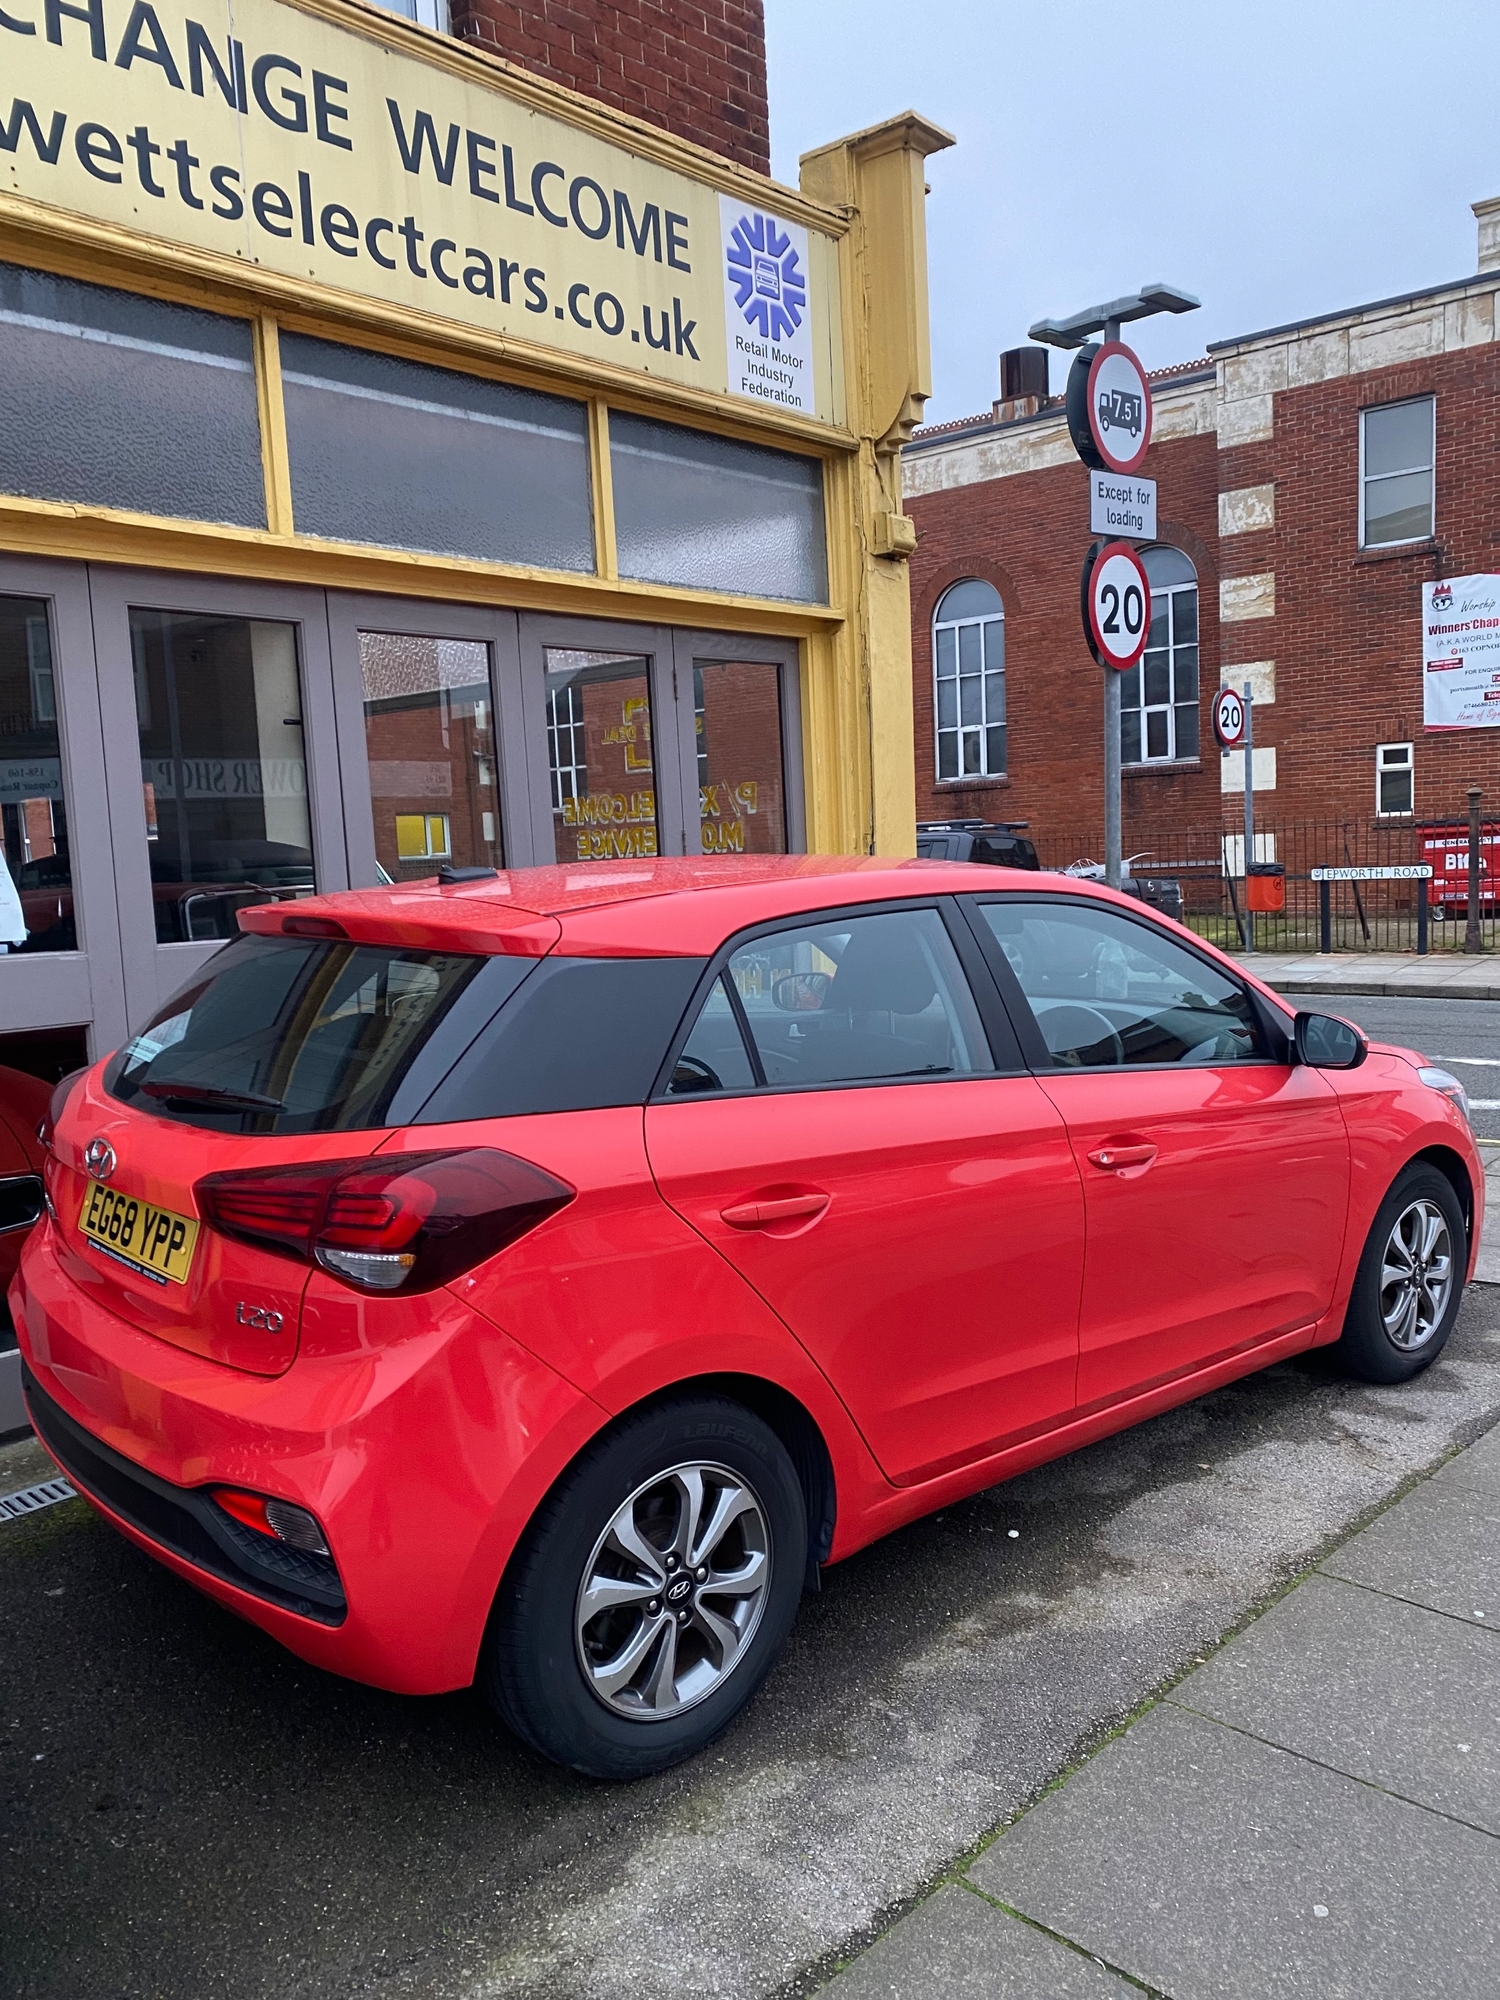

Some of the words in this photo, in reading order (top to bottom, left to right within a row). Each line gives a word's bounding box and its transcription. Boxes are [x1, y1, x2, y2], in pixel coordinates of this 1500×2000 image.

[0, 0, 353, 151] HANGE
[386, 97, 692, 273] WELCOME
[0, 97, 701, 361] wettselectcars.co.uk
[735, 335, 768, 359] Retail
[771, 347, 804, 369] Motor
[747, 359, 794, 389] Industry
[741, 377, 802, 407] Federation
[1098, 482, 1133, 504] Except
[1137, 488, 1151, 505] for
[1107, 508, 1143, 530] loading
[1101, 584, 1143, 635] 20
[1461, 598, 1496, 612] Worship
[1462, 634, 1493, 643] WORLD
[1221, 706, 1240, 728] 20
[1327, 868, 1383, 879] EPWORTH
[1394, 867, 1429, 877] ROAD
[86, 1184, 138, 1247] EG68
[140, 1207, 186, 1268] YPP
